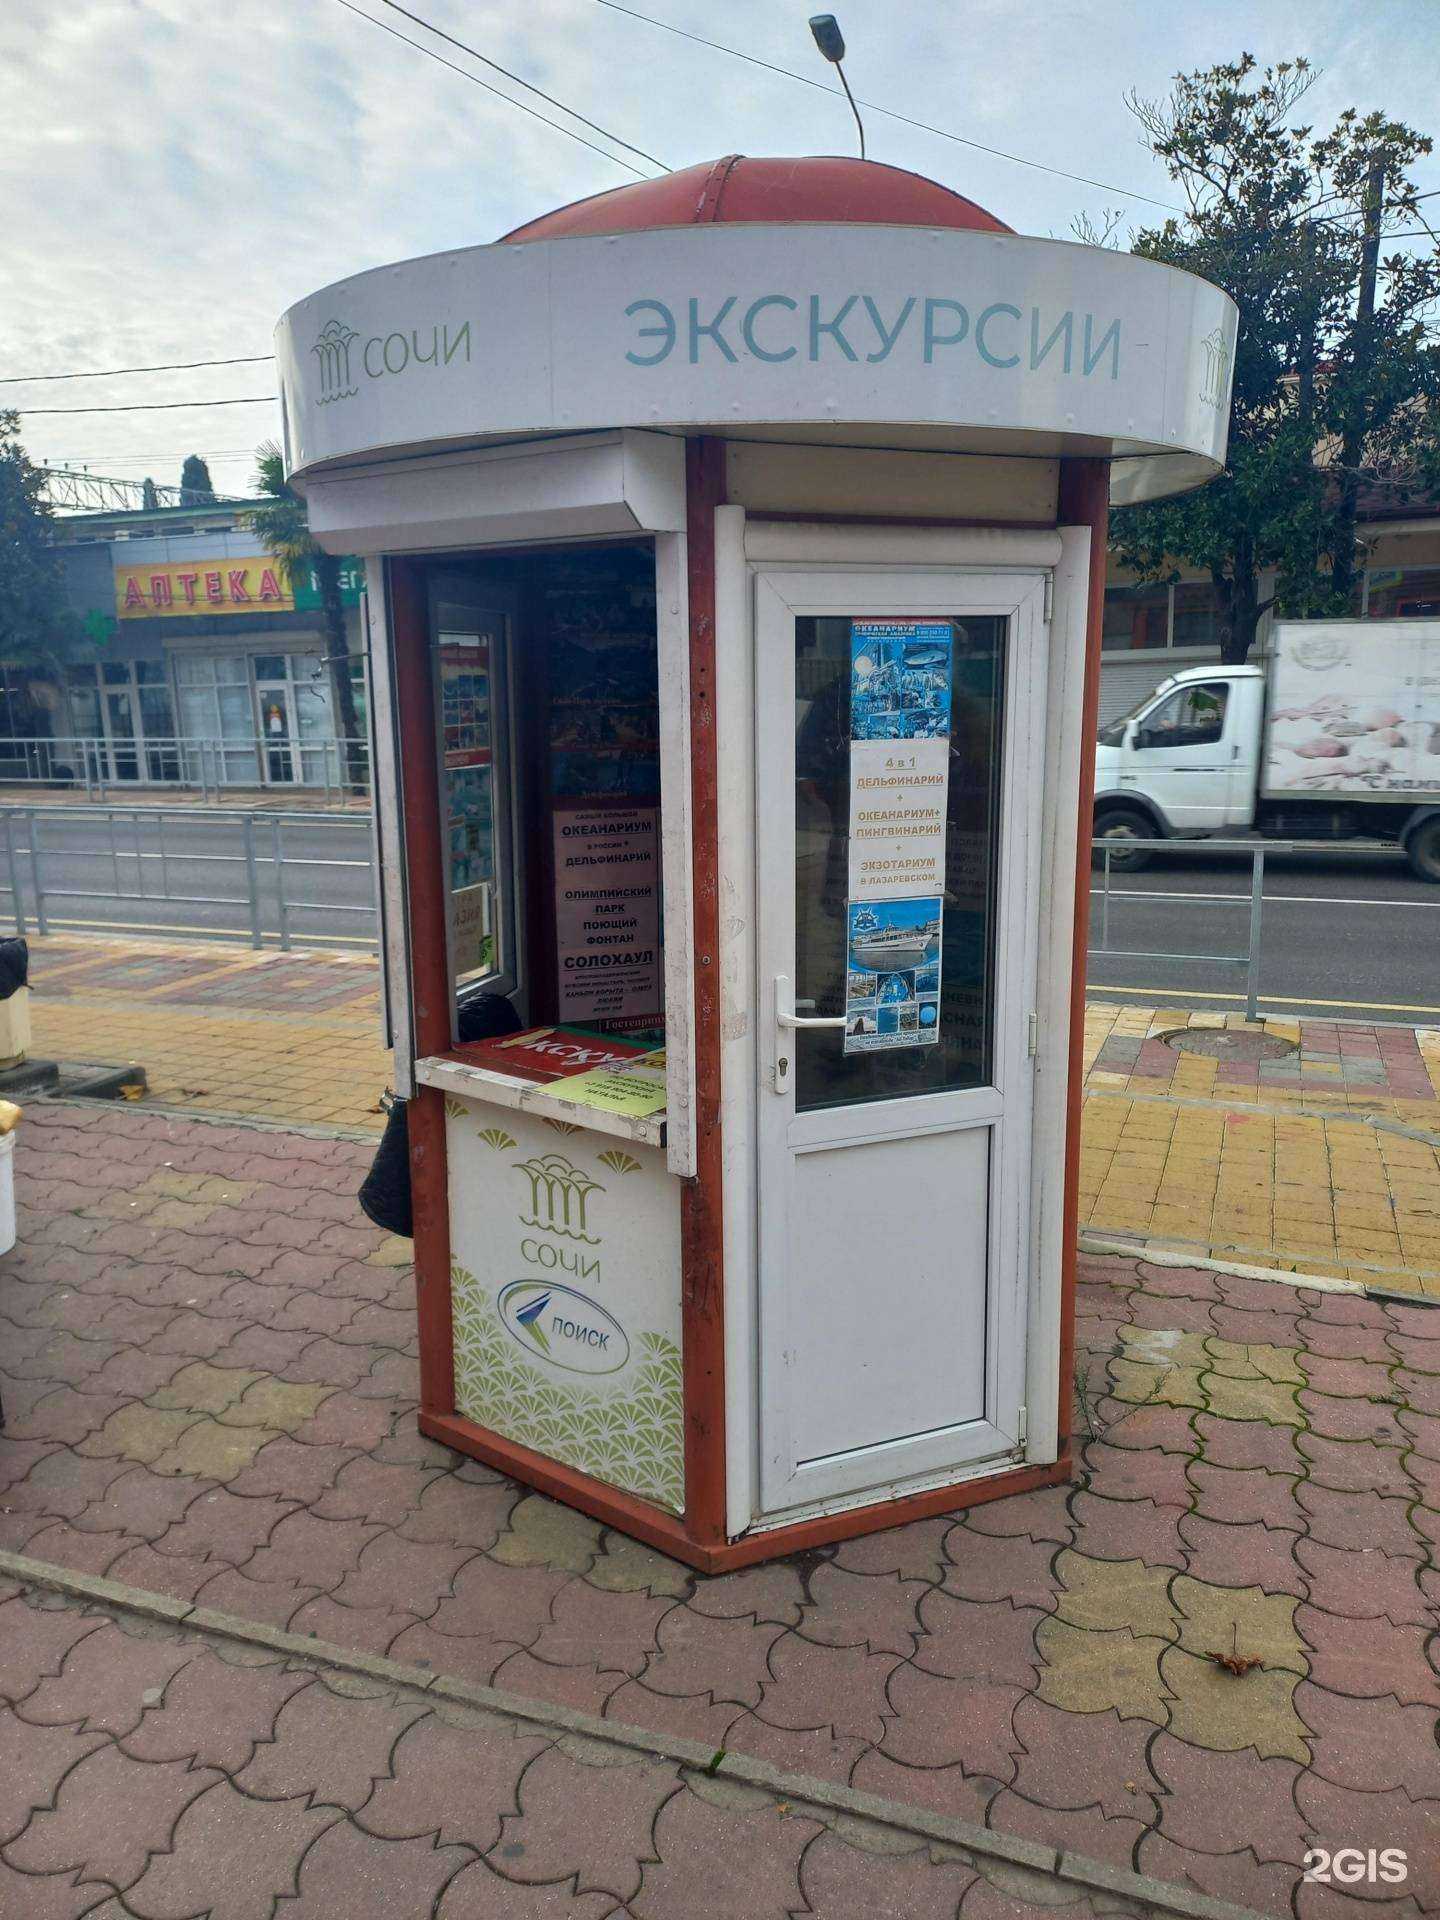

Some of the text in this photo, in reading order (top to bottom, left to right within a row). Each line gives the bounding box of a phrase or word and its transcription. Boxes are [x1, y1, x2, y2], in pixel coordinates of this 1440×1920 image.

[363, 294, 1122, 381] СОЧИ ЭКСКУРСИИ
[125, 570, 282, 608] АПТЕКА
[885, 758, 893, 768] 4
[908, 757, 915, 767] 1
[857, 774, 944, 789] ДЕЛЬФИНАРИЙ
[562, 821, 652, 836] ОКЕАНАРИУМ
[856, 823, 941, 838] ПИНГВИНАРИЙ
[566, 852, 651, 867] ДЕЛЬФИНАРИЙ
[860, 858, 935, 871] ЭКЗОТАРИУМ
[869, 873, 936, 885] ЛАЗАРЕВСКОМ
[565, 886, 652, 899] ОЛИМПИЙСКИЙ
[595, 904, 625, 913] ПАРК
[583, 918, 638, 930] ПОЮЩИЙ
[586, 934, 634, 944] ФОНТАН
[564, 951, 653, 968] СОЛОХАУЛ
[521, 1238, 601, 1283] СОЧИ
[552, 1316, 610, 1352] ПОИСК
